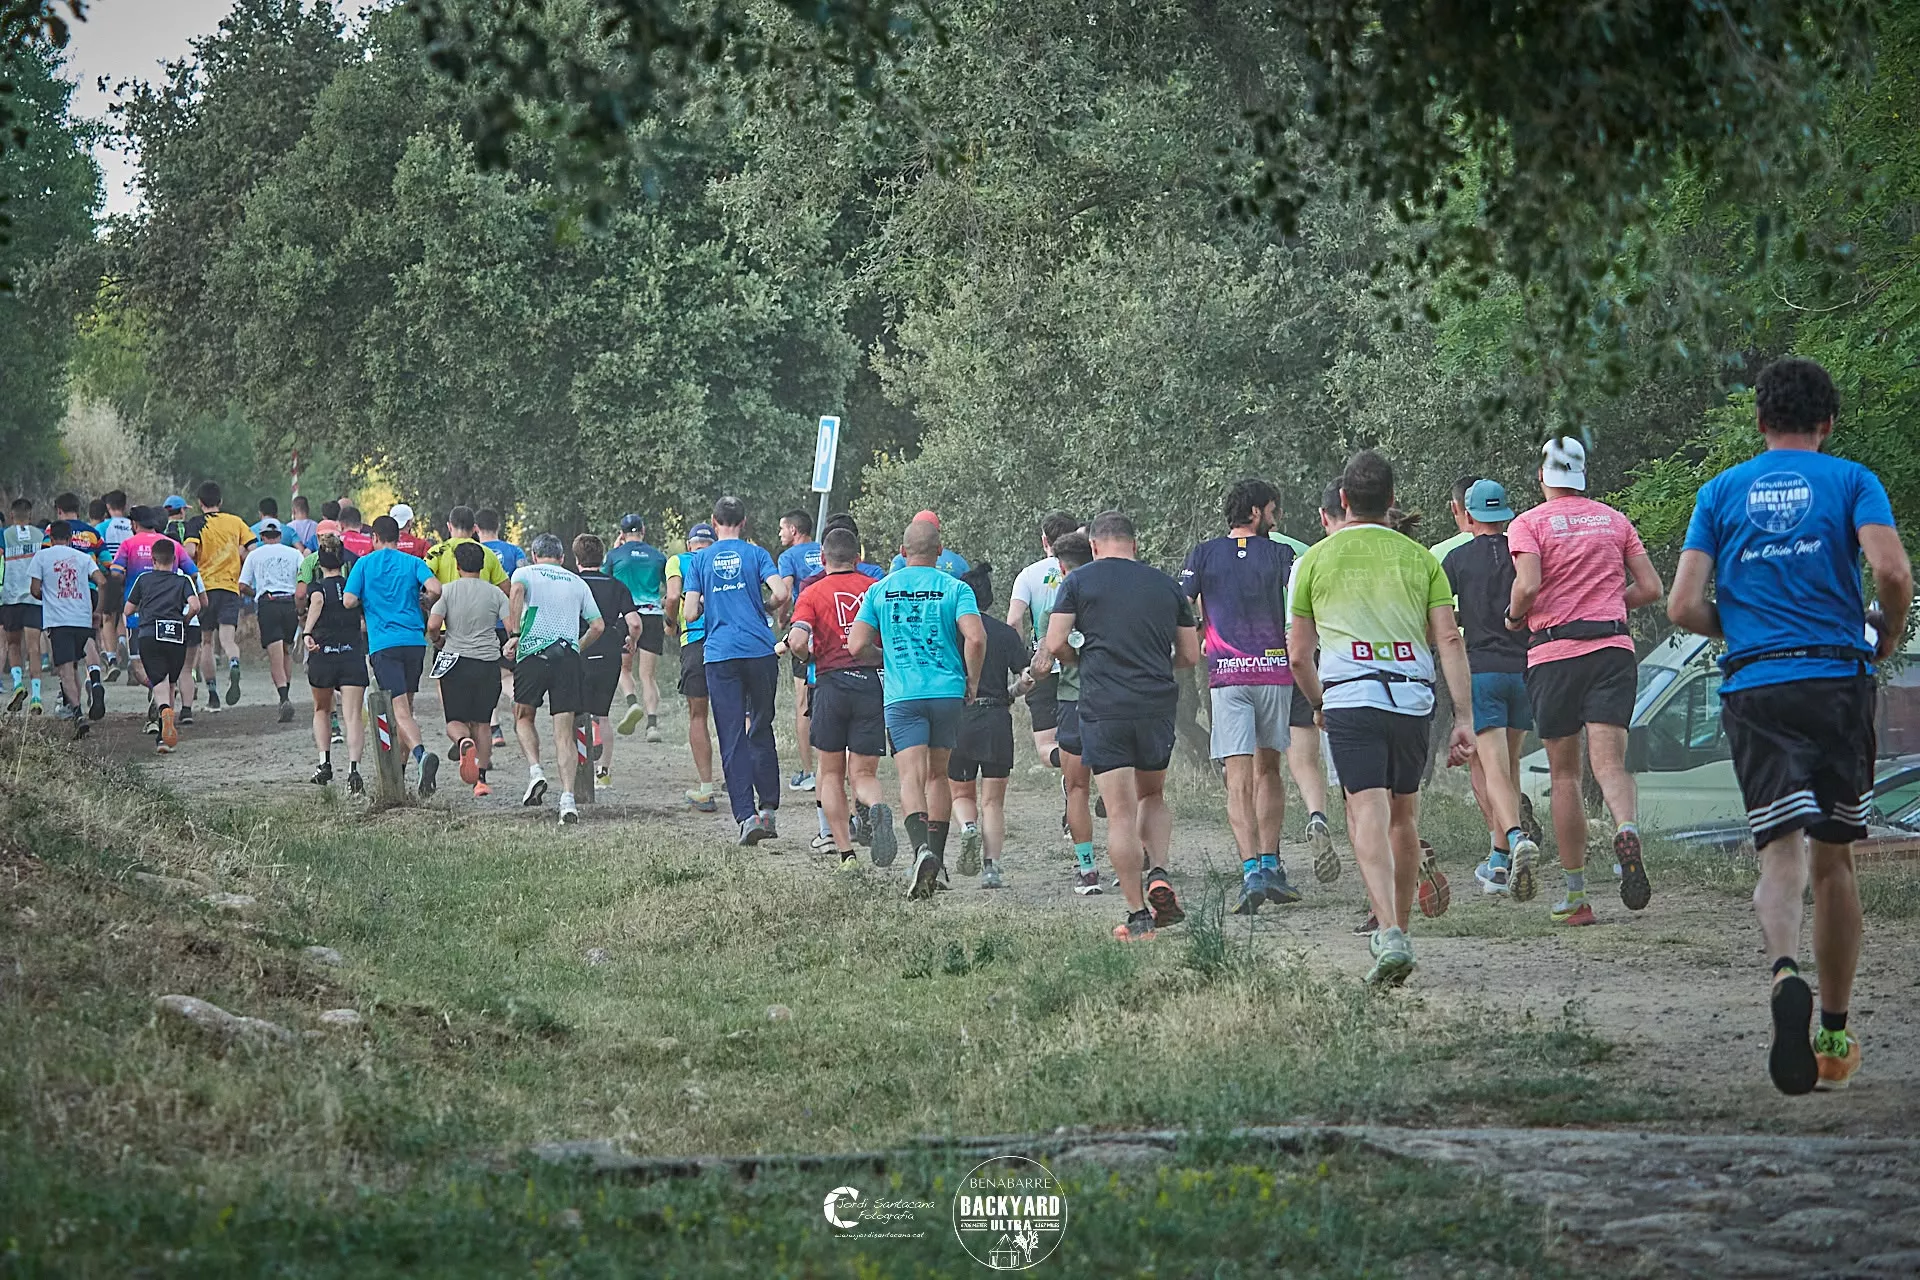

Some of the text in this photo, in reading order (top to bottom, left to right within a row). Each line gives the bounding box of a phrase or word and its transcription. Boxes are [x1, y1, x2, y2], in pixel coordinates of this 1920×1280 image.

[816, 425, 832, 482] P
[1750, 487, 1810, 504] BACKYARD
[164, 624, 176, 632] 92
[1216, 656, 1288, 669] TRENCACIMS
